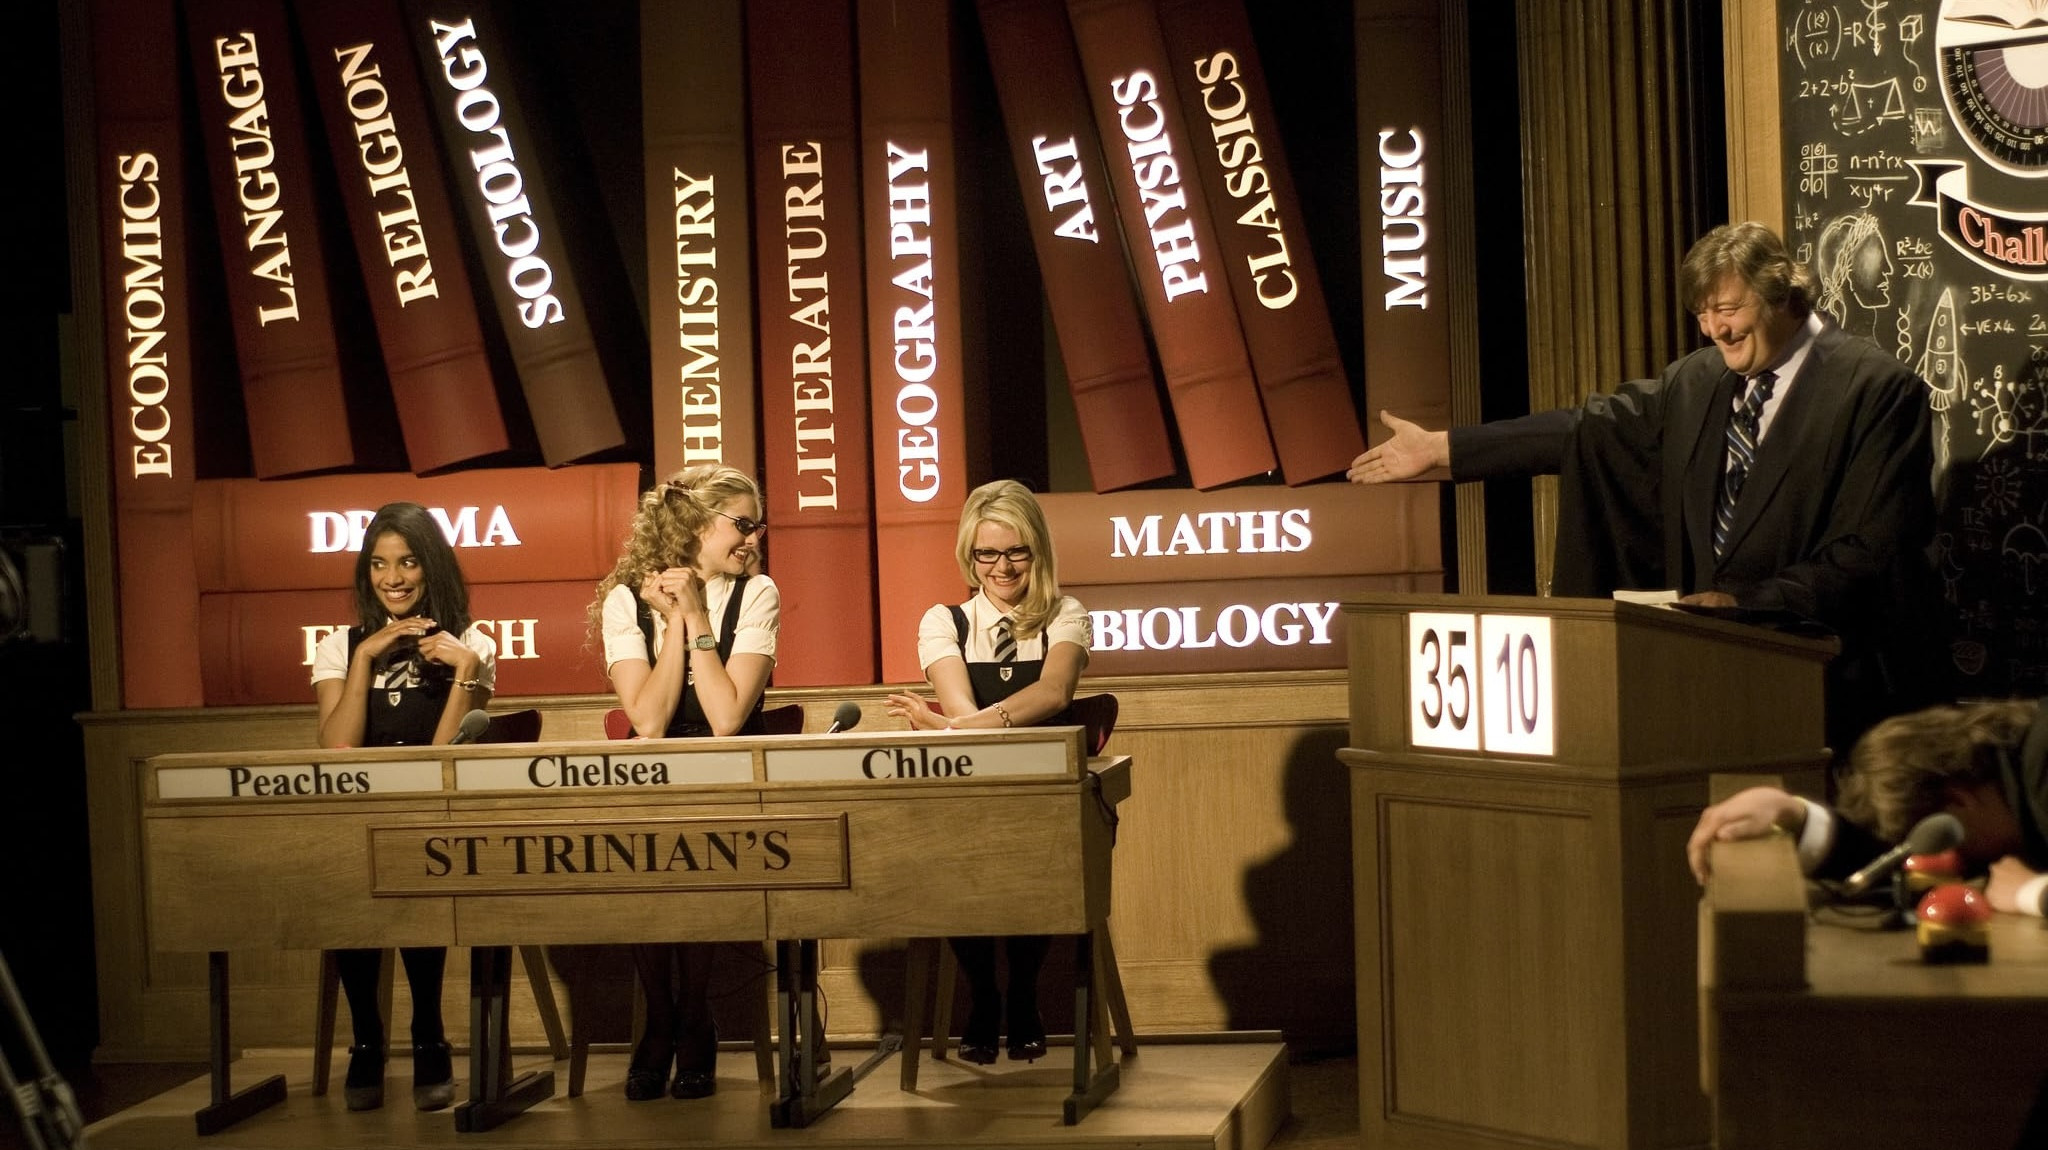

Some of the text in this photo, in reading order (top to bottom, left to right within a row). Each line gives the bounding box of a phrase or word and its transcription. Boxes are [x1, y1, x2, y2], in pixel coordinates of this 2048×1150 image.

[216, 32, 300, 327] LANGUAGE
[335, 42, 439, 308] RELIGION
[430, 17, 565, 330] SOCIOLOGY
[1032, 136, 1099, 244] ART
[1111, 69, 1209, 303] PHYSICS
[1195, 50, 1298, 310] CLASSICS
[1378, 126, 1428, 312] MUSIC
[1958, 206, 2048, 266] Chall
[118, 152, 173, 479] ECONOMICS
[674, 166, 723, 469] HEMISTRY
[782, 141, 838, 512] LITERATURE
[886, 141, 941, 502] GEOGRAPHY
[308, 505, 521, 553] DRMA
[1109, 508, 1312, 557] MATHS
[1088, 602, 1340, 651] BIOLOGY
[1420, 628, 1538, 734] 35 10
[227, 763, 370, 797] Peaches
[528, 754, 670, 788] Chelsea
[862, 747, 973, 779] Chloe
[425, 830, 791, 876] ST TRINIAN'S
